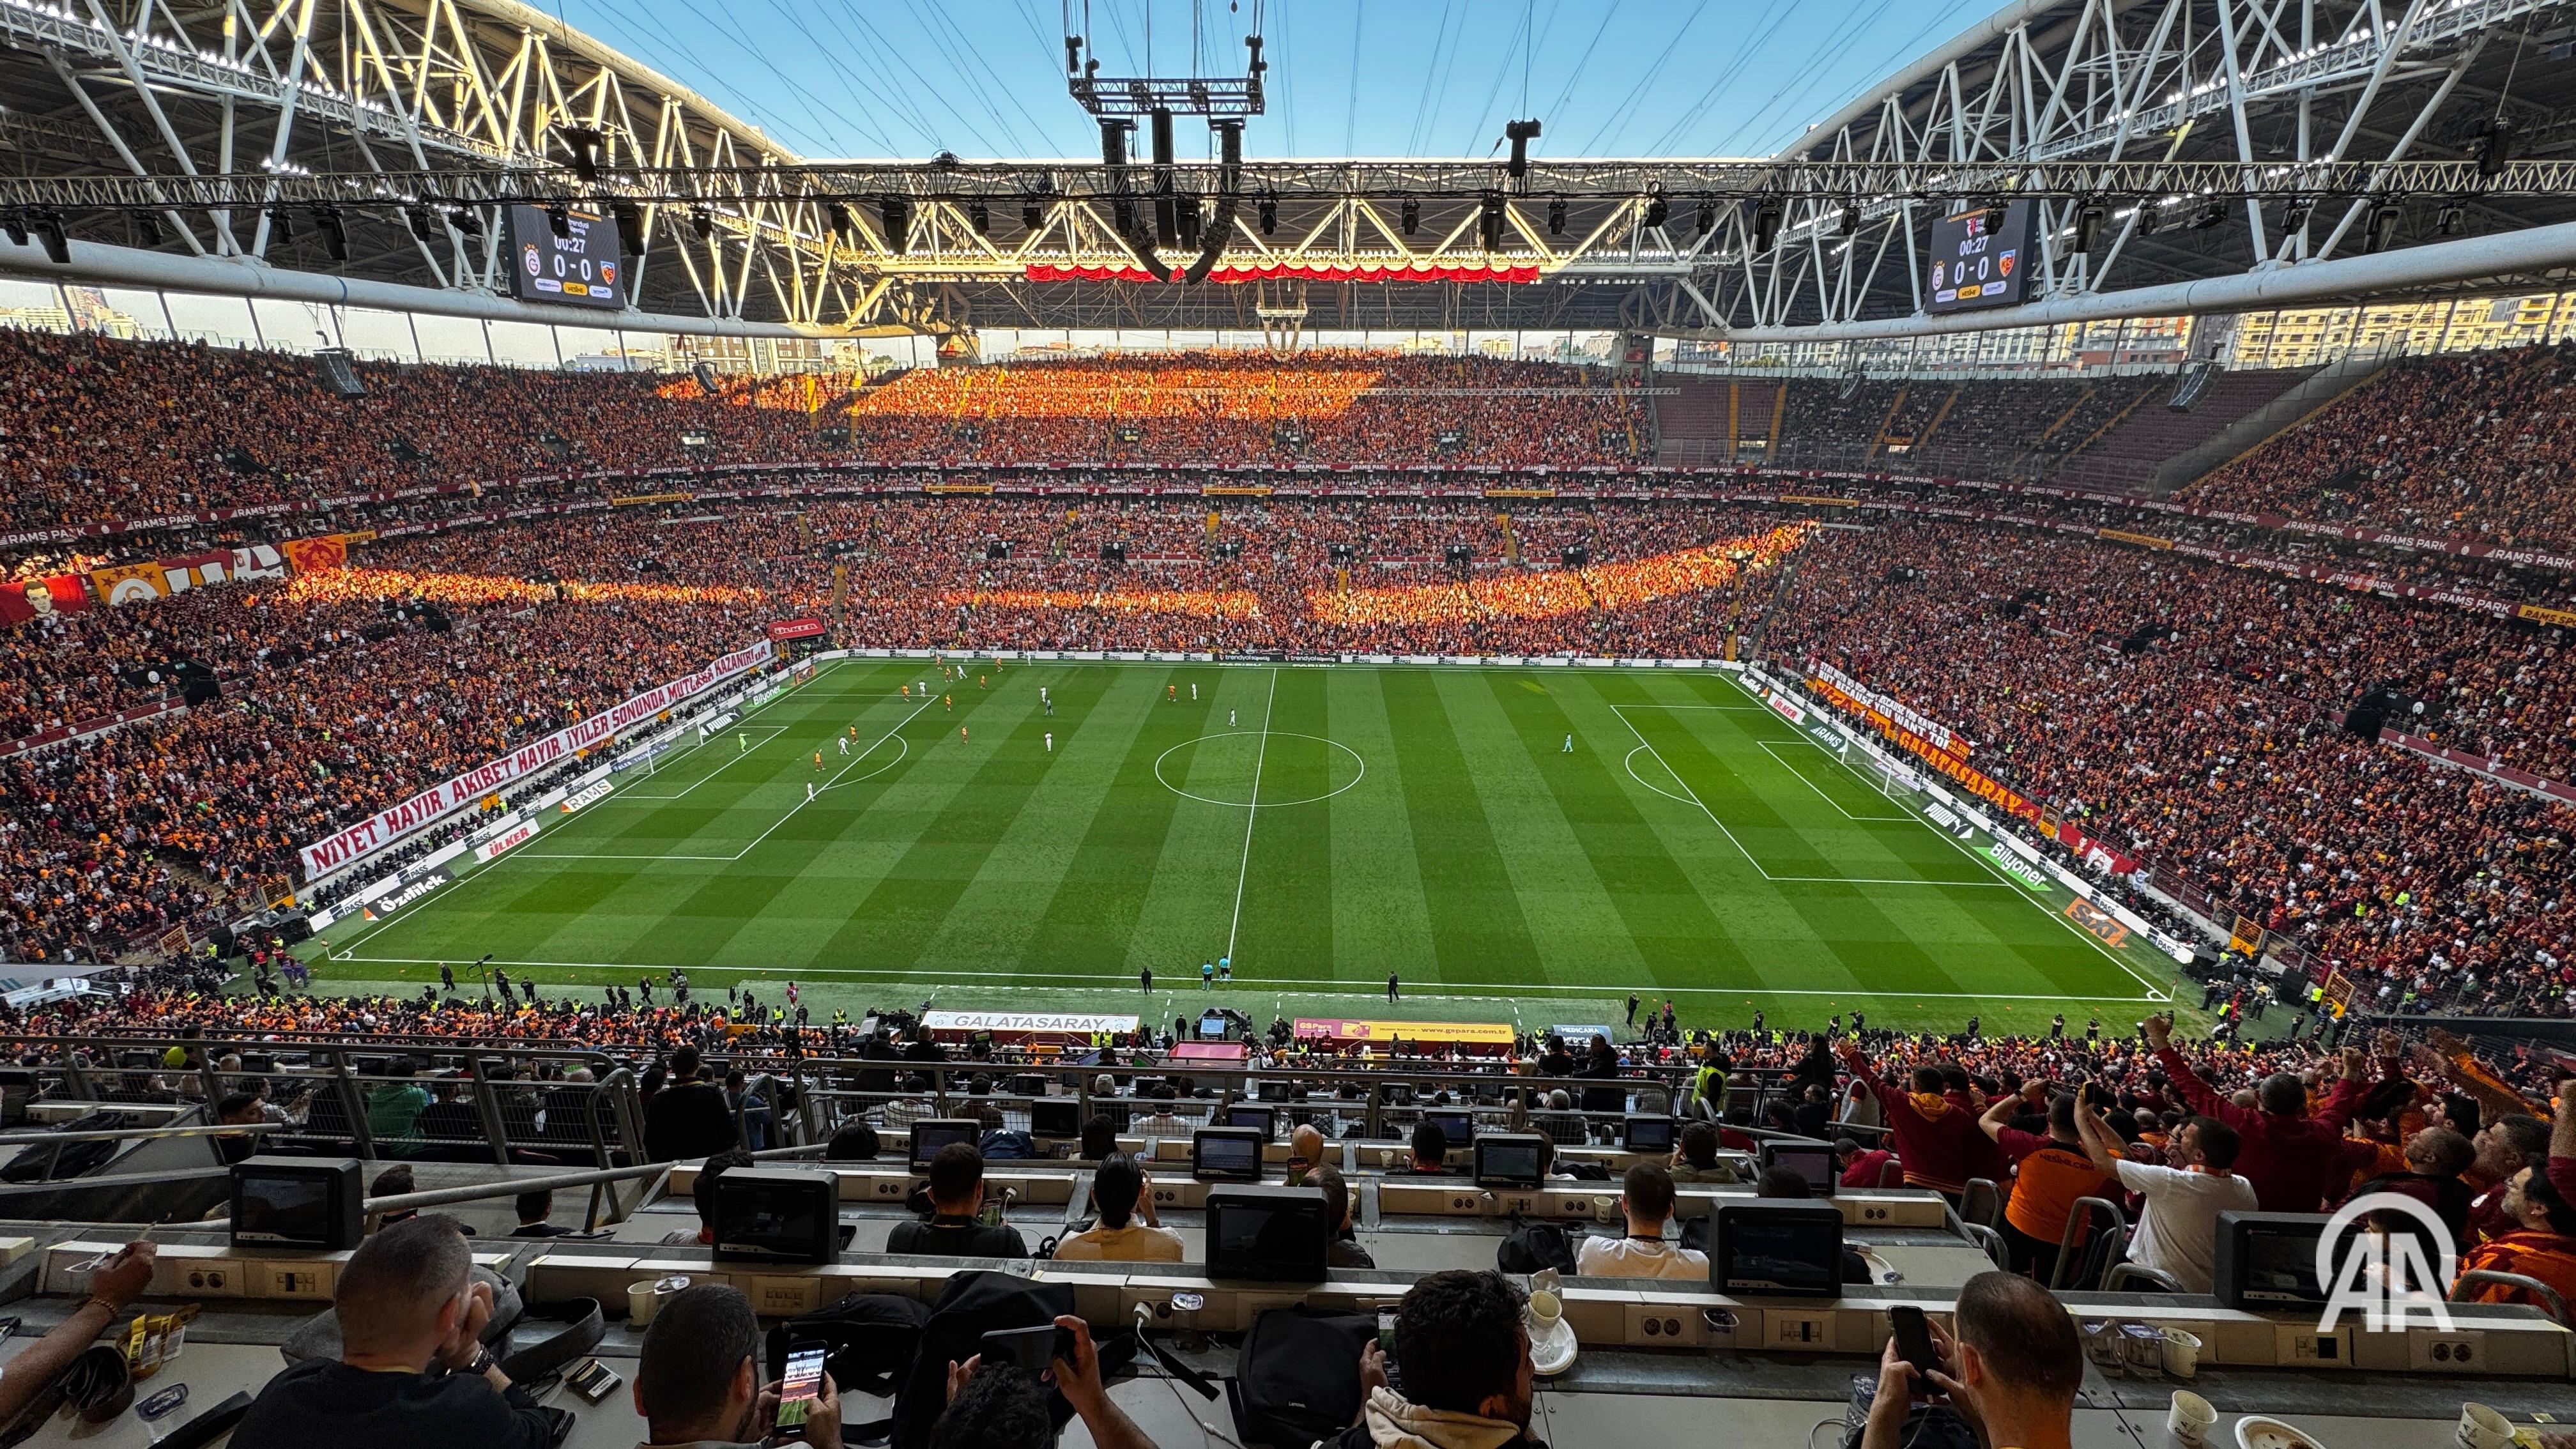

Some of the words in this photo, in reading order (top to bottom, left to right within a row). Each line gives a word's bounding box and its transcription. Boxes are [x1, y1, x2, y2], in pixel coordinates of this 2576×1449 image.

[1959, 236, 1989, 257] 00:27
[544, 474, 560, 482] PARK
[586, 471, 606, 479] RAMS
[399, 489, 419, 498] RAMS
[420, 486, 439, 495] PARK
[1981, 482, 2000, 490] PARK
[326, 497, 349, 507] RAMS
[349, 494, 370, 505] PARK
[2087, 492, 2104, 500] RAMS
[2106, 494, 2123, 503] PARK
[238, 506, 266, 518] RAMS
[267, 503, 291, 515] PARK
[509, 509, 528, 518] RAMS
[529, 506, 546, 515] PARK
[571, 502, 590, 510] RAMS
[1954, 509, 1974, 517] PARK
[2145, 501, 2163, 510] RAMS
[2165, 503, 2186, 513] PARK
[132, 516, 167, 530] RAMS
[169, 514, 199, 528] PARK
[450, 518, 469, 526] RAMS
[470, 514, 486, 524] PARK
[1998, 514, 2018, 523] RAMS
[2019, 517, 2037, 525] PARK
[2213, 510, 2235, 520] RAMS
[2235, 513, 2258, 523] PARK
[385, 528, 406, 537] RAMS
[406, 525, 426, 535] PARK
[2290, 521, 2317, 532] RAMS
[2318, 525, 2345, 537] PARK
[7, 530, 49, 544] RAMS
[2382, 534, 2414, 547] RAMS
[2416, 539, 2448, 551] PARK
[2179, 545, 2202, 556] RAMS
[2204, 549, 2222, 559] PARK
[2494, 549, 2533, 564] RAMS
[2535, 555, 2575, 569] PARK
[2251, 558, 2275, 569] RAMS
[2276, 562, 2301, 574] PARK
[2439, 592, 2474, 607] RAMS
[2475, 599, 2512, 613] PARK
[2524, 609, 2556, 623] RAMS
[1225, 654, 1251, 662] trendyol
[753, 685, 781, 705] Bilyoner
[1820, 661, 1834, 675] STAY
[1906, 709, 1919, 721] YOU
[1918, 714, 1937, 731] HAVE
[1773, 697, 1798, 719] ÜLKER
[1818, 670, 1835, 686] BUT
[1835, 680, 1873, 709] BECAUSE
[1874, 702, 1892, 718] YOU
[1894, 711, 1926, 736] WANT
[707, 714, 733, 733] PUMA
[1818, 726, 1843, 747] RAMS
[451, 756, 512, 804] AKIBET
[612, 691, 666, 730] SONUNDA
[1898, 731, 2023, 813] GALATASARAY
[567, 781, 610, 809] RAMS
[1923, 802, 1956, 827] PUMA
[488, 826, 530, 856] ÜLKER
[1989, 842, 2047, 886] Bilyoner
[377, 875, 447, 912] Özdilek
[2099, 900, 2116, 917] PASS
[2156, 939, 2176, 956] PASS
[2237, 941, 2248, 951] 24
[954, 1015, 1107, 1029] GALATASARAY
[1420, 1027, 1506, 1035] www.gspara.com.tr
